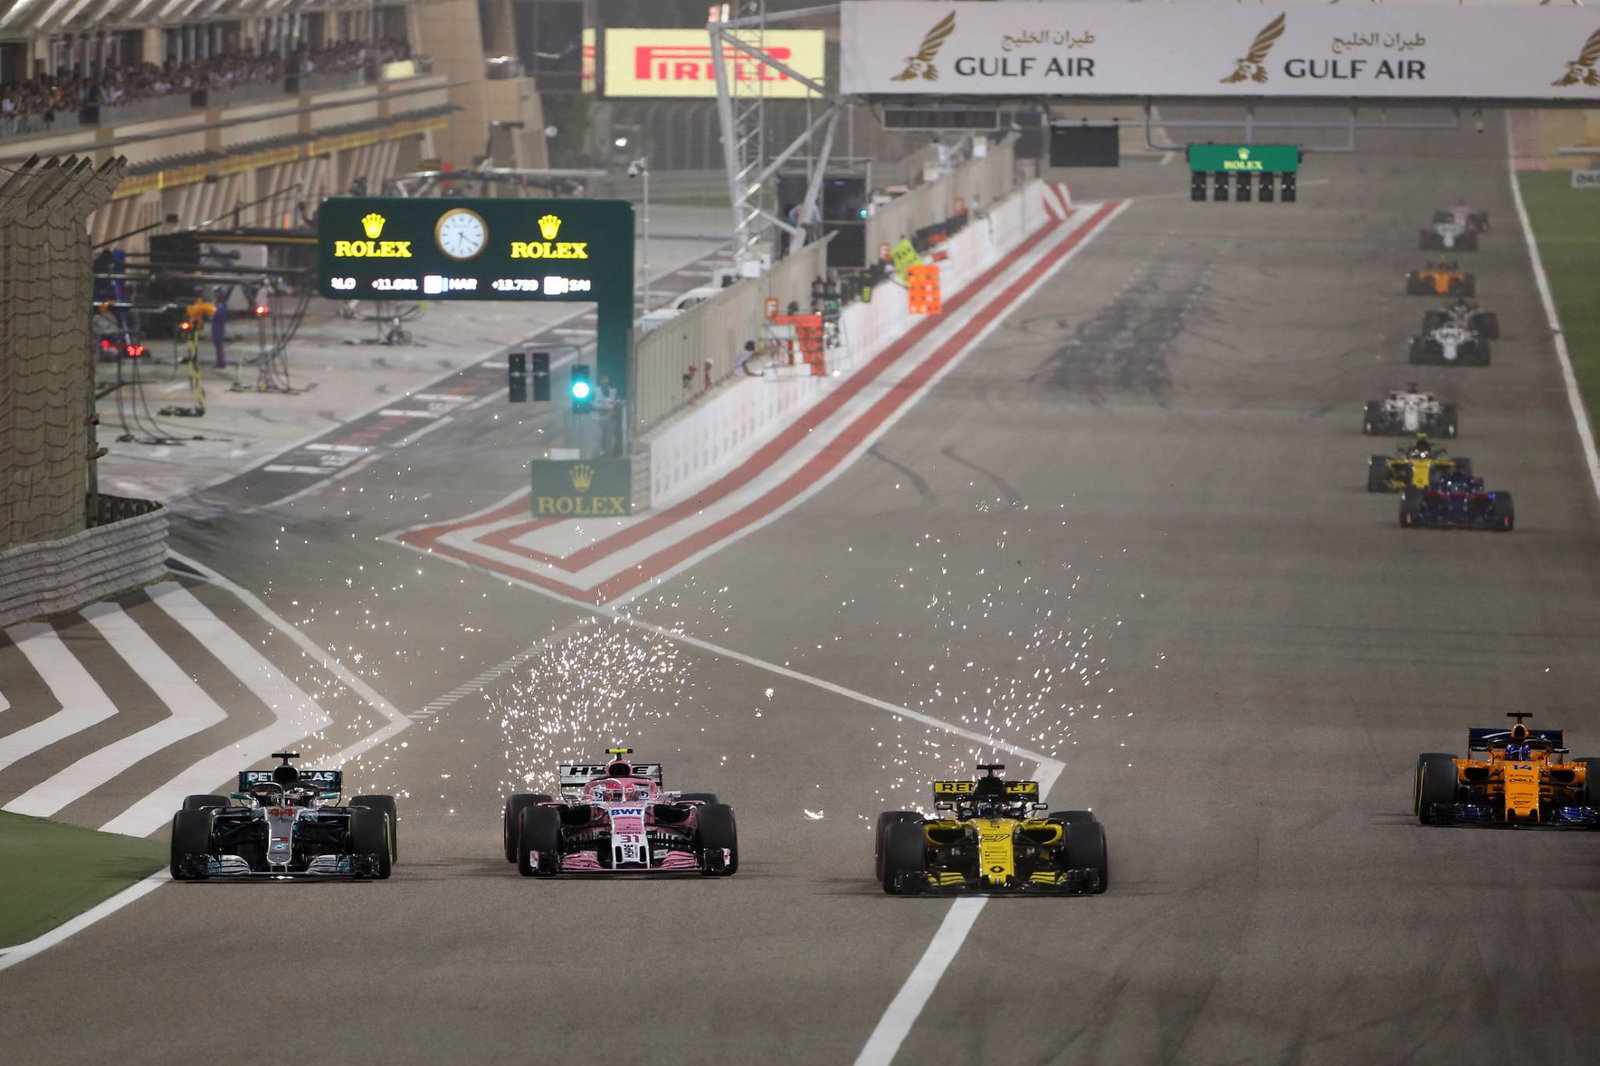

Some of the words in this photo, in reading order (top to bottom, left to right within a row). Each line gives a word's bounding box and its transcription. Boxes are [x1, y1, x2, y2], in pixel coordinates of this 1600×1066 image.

[1001, 29, 1050, 52] الخليج
[1053, 29, 1096, 49] طيران
[1331, 31, 1380, 54] الخليج
[1383, 31, 1427, 52] طيران
[954, 56, 1037, 77] GULF
[1045, 57, 1095, 77] AIR
[1284, 58, 1367, 79] GULF
[1375, 59, 1426, 80] AIR
[1223, 160, 1263, 170] ROLEX
[334, 240, 412, 258] ROLEX
[510, 241, 589, 259] ROLEX
[537, 496, 625, 513] ROLEX
[269, 808, 295, 817] 44
[620, 835, 640, 843] 31
